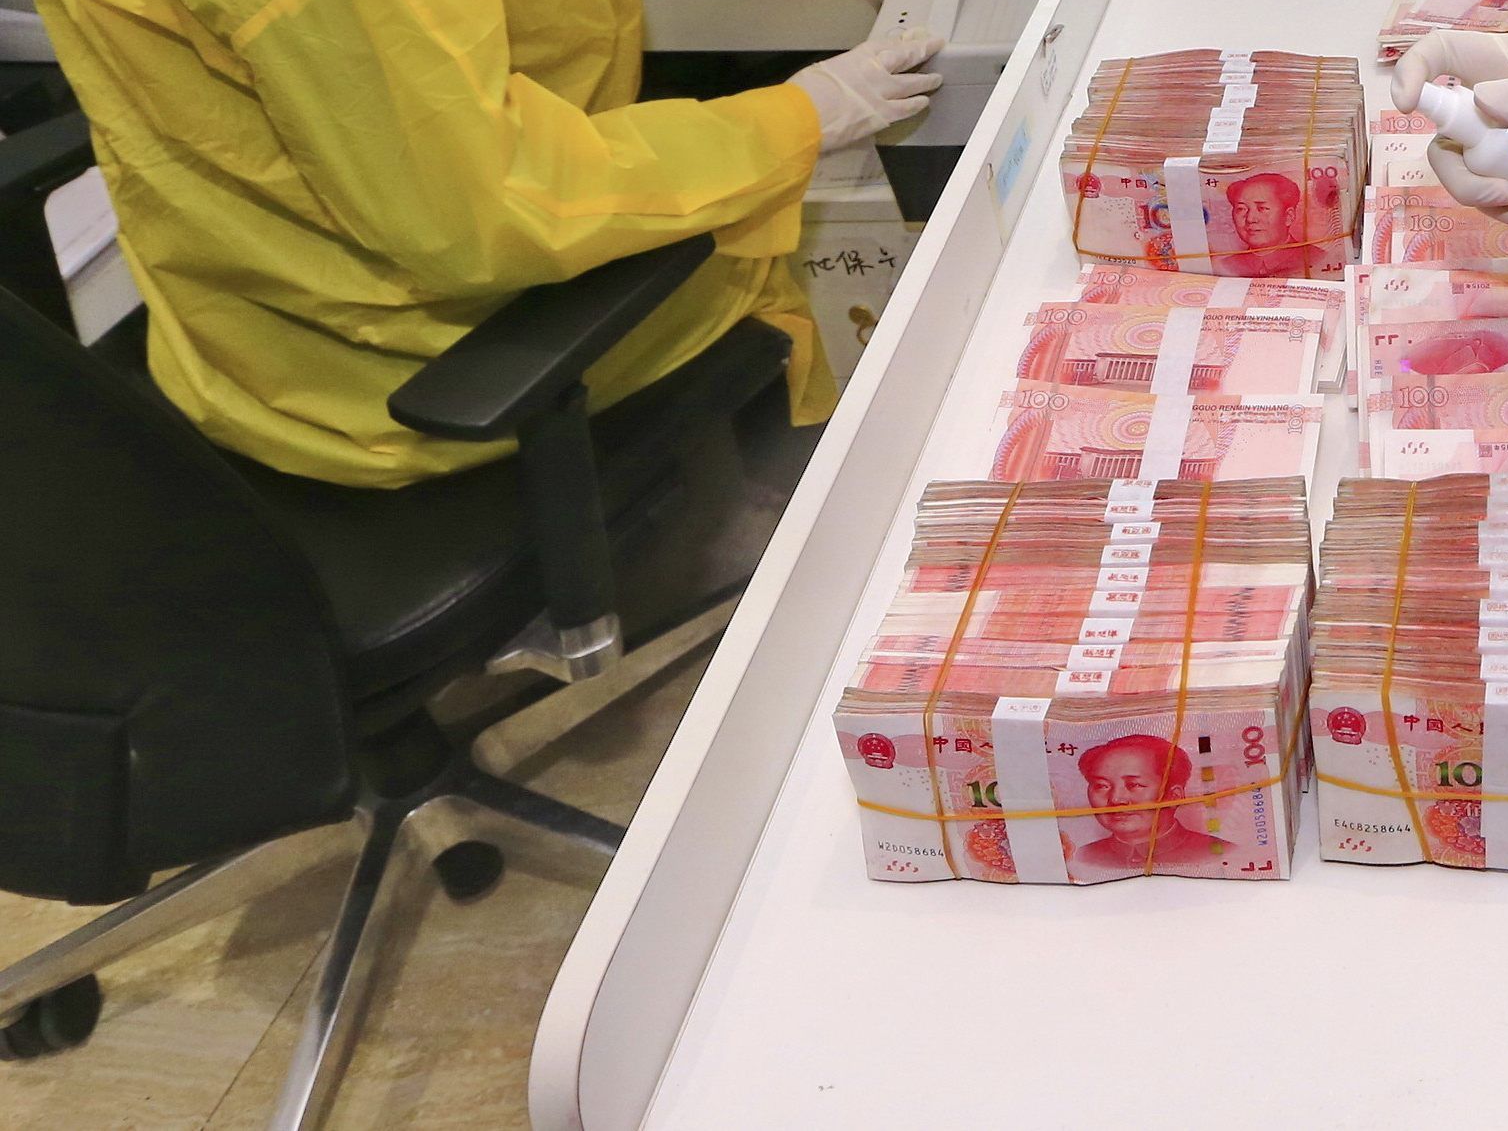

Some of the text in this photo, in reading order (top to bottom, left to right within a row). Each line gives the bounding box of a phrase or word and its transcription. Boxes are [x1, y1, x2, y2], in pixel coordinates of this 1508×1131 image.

[1386, 117, 1426, 132] 100
[1410, 214, 1454, 232] 100
[1093, 271, 1138, 287] 100
[1042, 308, 1088, 325] 100
[1018, 389, 1070, 410] 100
[1400, 385, 1449, 408] 100
[1218, 404, 1251, 412] RENMIN
[1251, 404, 1289, 412] YINHANG
[1241, 725, 1265, 768] 100
[1253, 781, 1268, 846] W2D058684
[1334, 818, 1412, 834] E4C8258644
[877, 840, 946, 858] W2D058684
